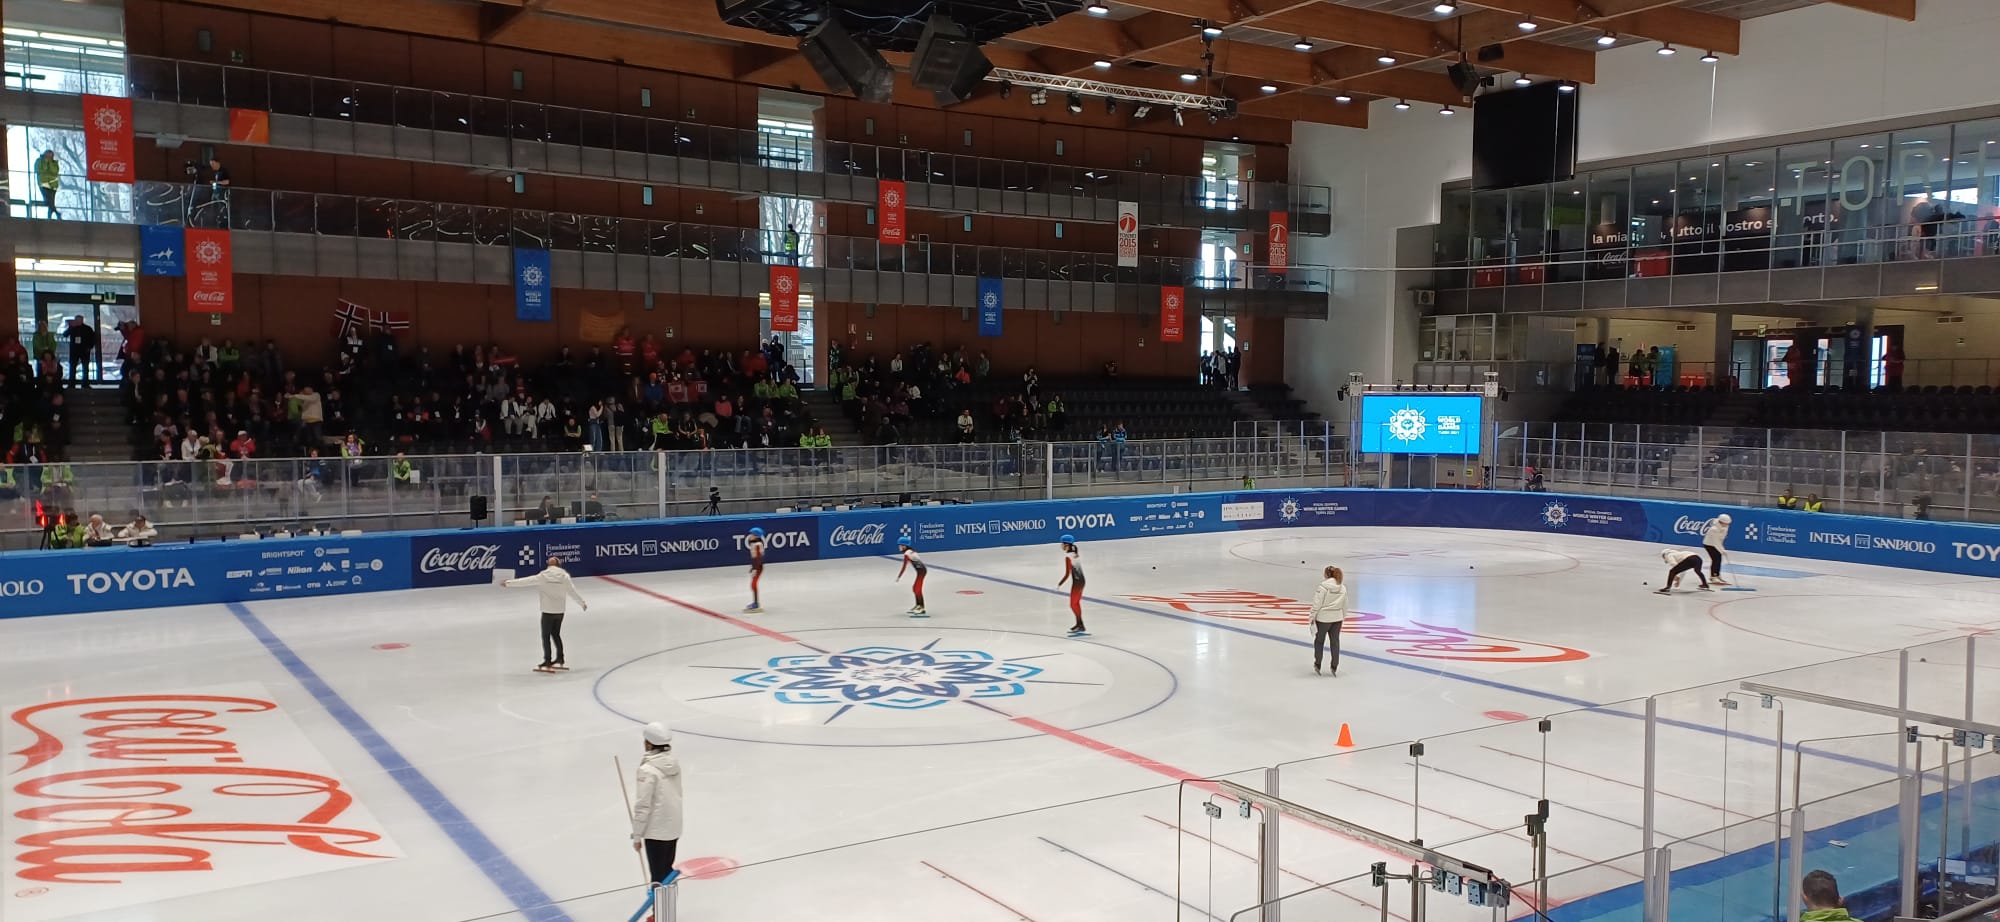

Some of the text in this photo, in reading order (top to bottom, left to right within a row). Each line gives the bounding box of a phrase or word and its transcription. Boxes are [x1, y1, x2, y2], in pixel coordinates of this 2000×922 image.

[1706, 223, 1715, 234] il
[1719, 220, 1763, 232] ostro
[1119, 238, 1136, 247] 2015
[1593, 234, 1603, 244] la
[1606, 232, 1627, 243] mia
[1270, 247, 1286, 256] 2015
[955, 519, 1046, 535] INTESA SANPAOLO
[1056, 513, 1115, 530] TOYOTA
[1674, 515, 1712, 536] Coca-C
[830, 523, 888, 547] Coca-Cola
[1809, 531, 1936, 553] INTESA SANPAOLO
[262, 550, 305, 559] BRIGHTSPOT
[595, 538, 719, 557] INTESA SANPAOLO
[1951, 542, 2000, 561] TOY
[420, 544, 502, 573] Coca-Cola
[226, 570, 253, 579] ESPN
[287, 566, 313, 575] Nikon
[0, 579, 44, 597] OLO
[67, 567, 195, 595] TOYOTA
[8, 694, 398, 885] Coca-Cola
